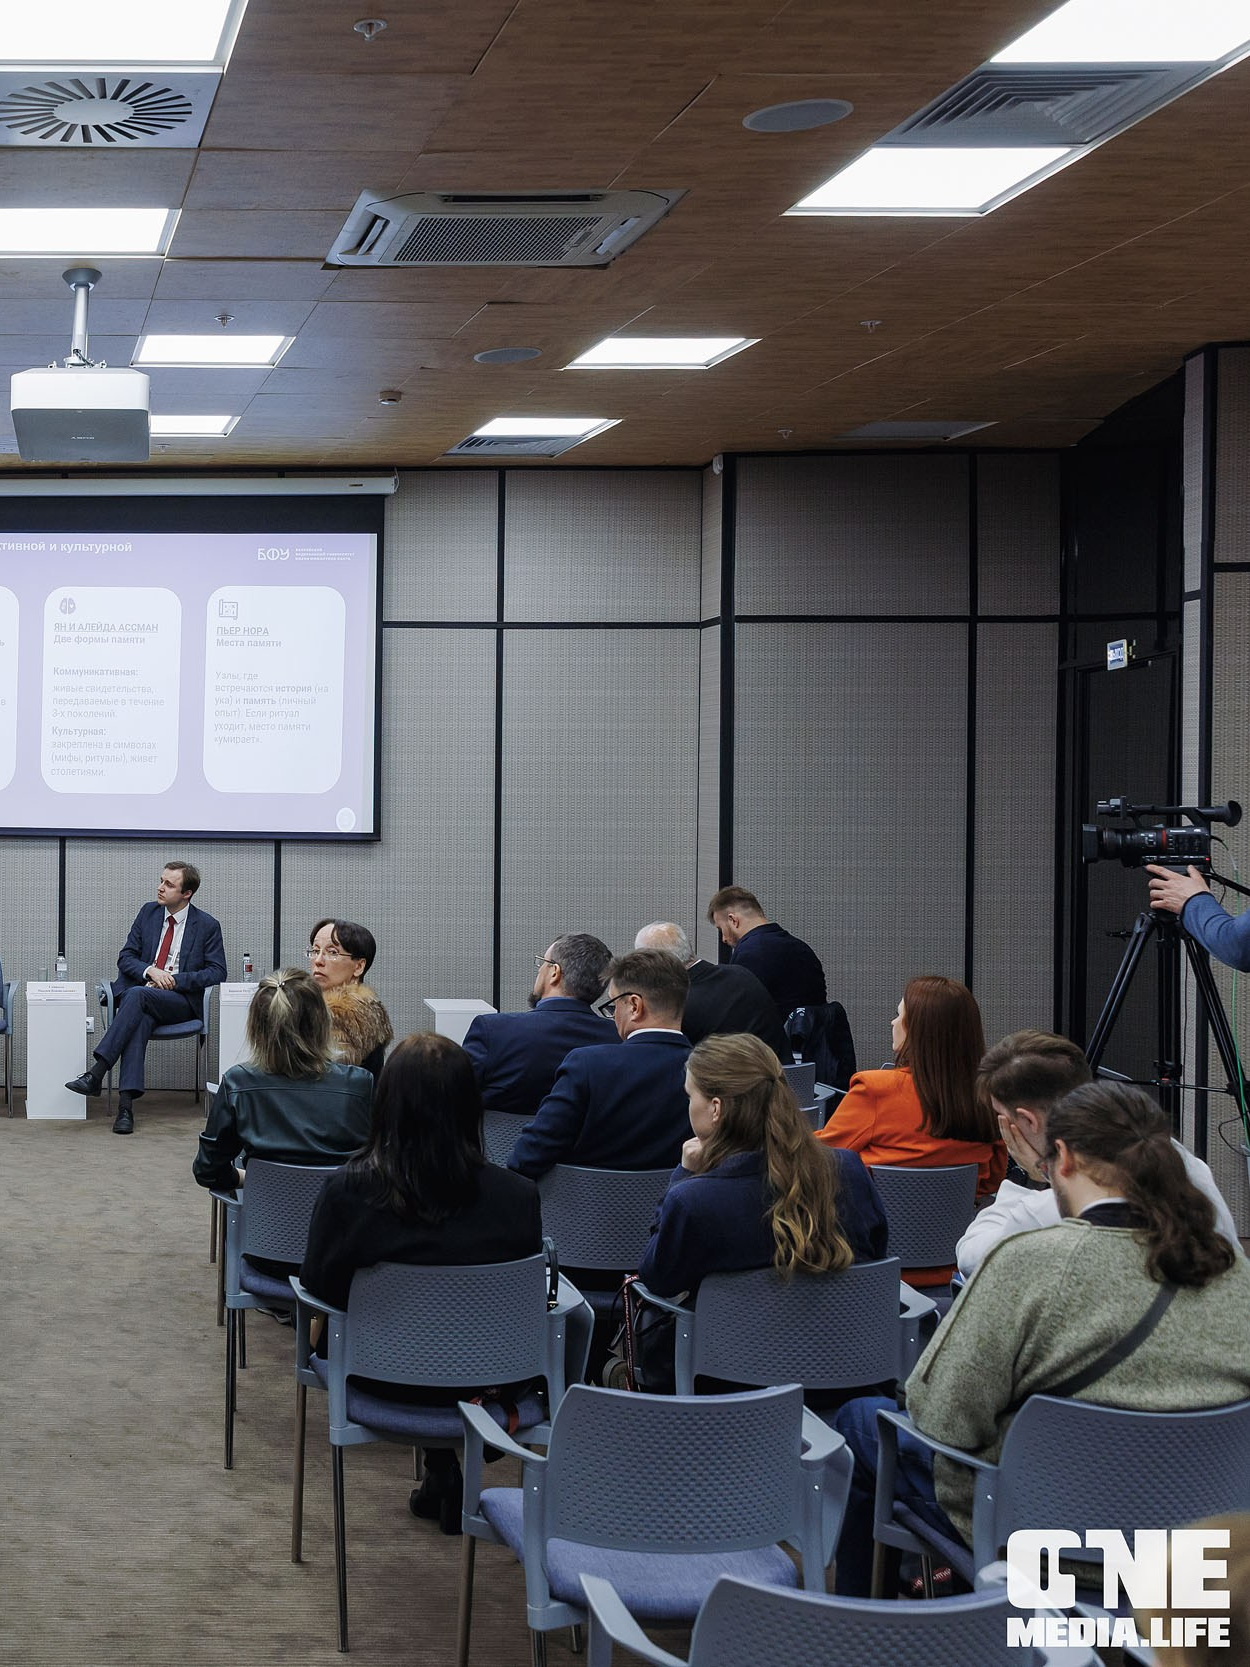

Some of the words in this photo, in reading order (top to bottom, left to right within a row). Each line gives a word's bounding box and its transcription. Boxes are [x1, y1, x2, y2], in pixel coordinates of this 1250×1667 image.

[49, 543, 58, 552] и
[60, 541, 133, 554] культурной
[258, 548, 290, 560] БФУ
[53, 622, 66, 632] ЯН
[68, 622, 76, 632] И
[78, 621, 116, 633] АЛЕЙДА
[118, 623, 159, 633] АССМАН
[216, 626, 241, 635] ПЬЕР
[242, 626, 270, 635] НОРА
[53, 635, 72, 644] Две
[74, 635, 109, 645] формы
[111, 636, 146, 645] памяти
[216, 638, 245, 647] Места
[247, 639, 282, 647] памяти
[53, 667, 139, 677] Коммуникативная:
[243, 672, 259, 681] где
[53, 685, 84, 693] живые
[215, 684, 273, 694] встречаются
[275, 685, 312, 694] история
[1, 698, 7, 706] в
[52, 697, 118, 707] передаваемые
[120, 698, 127, 706] в
[129, 698, 165, 706] течение
[235, 697, 241, 705] и
[243, 697, 277, 705] память
[278, 696, 317, 705] (личный
[245, 708, 267, 718] Если
[269, 709, 300, 719] ритуал
[52, 726, 107, 737] Культурная:
[249, 723, 276, 731] место
[278, 723, 312, 732] памяти
[51, 740, 104, 750] закреплена
[105, 741, 112, 749] в
[113, 741, 157, 749] символах
[50, 767, 106, 776] столетиями.
